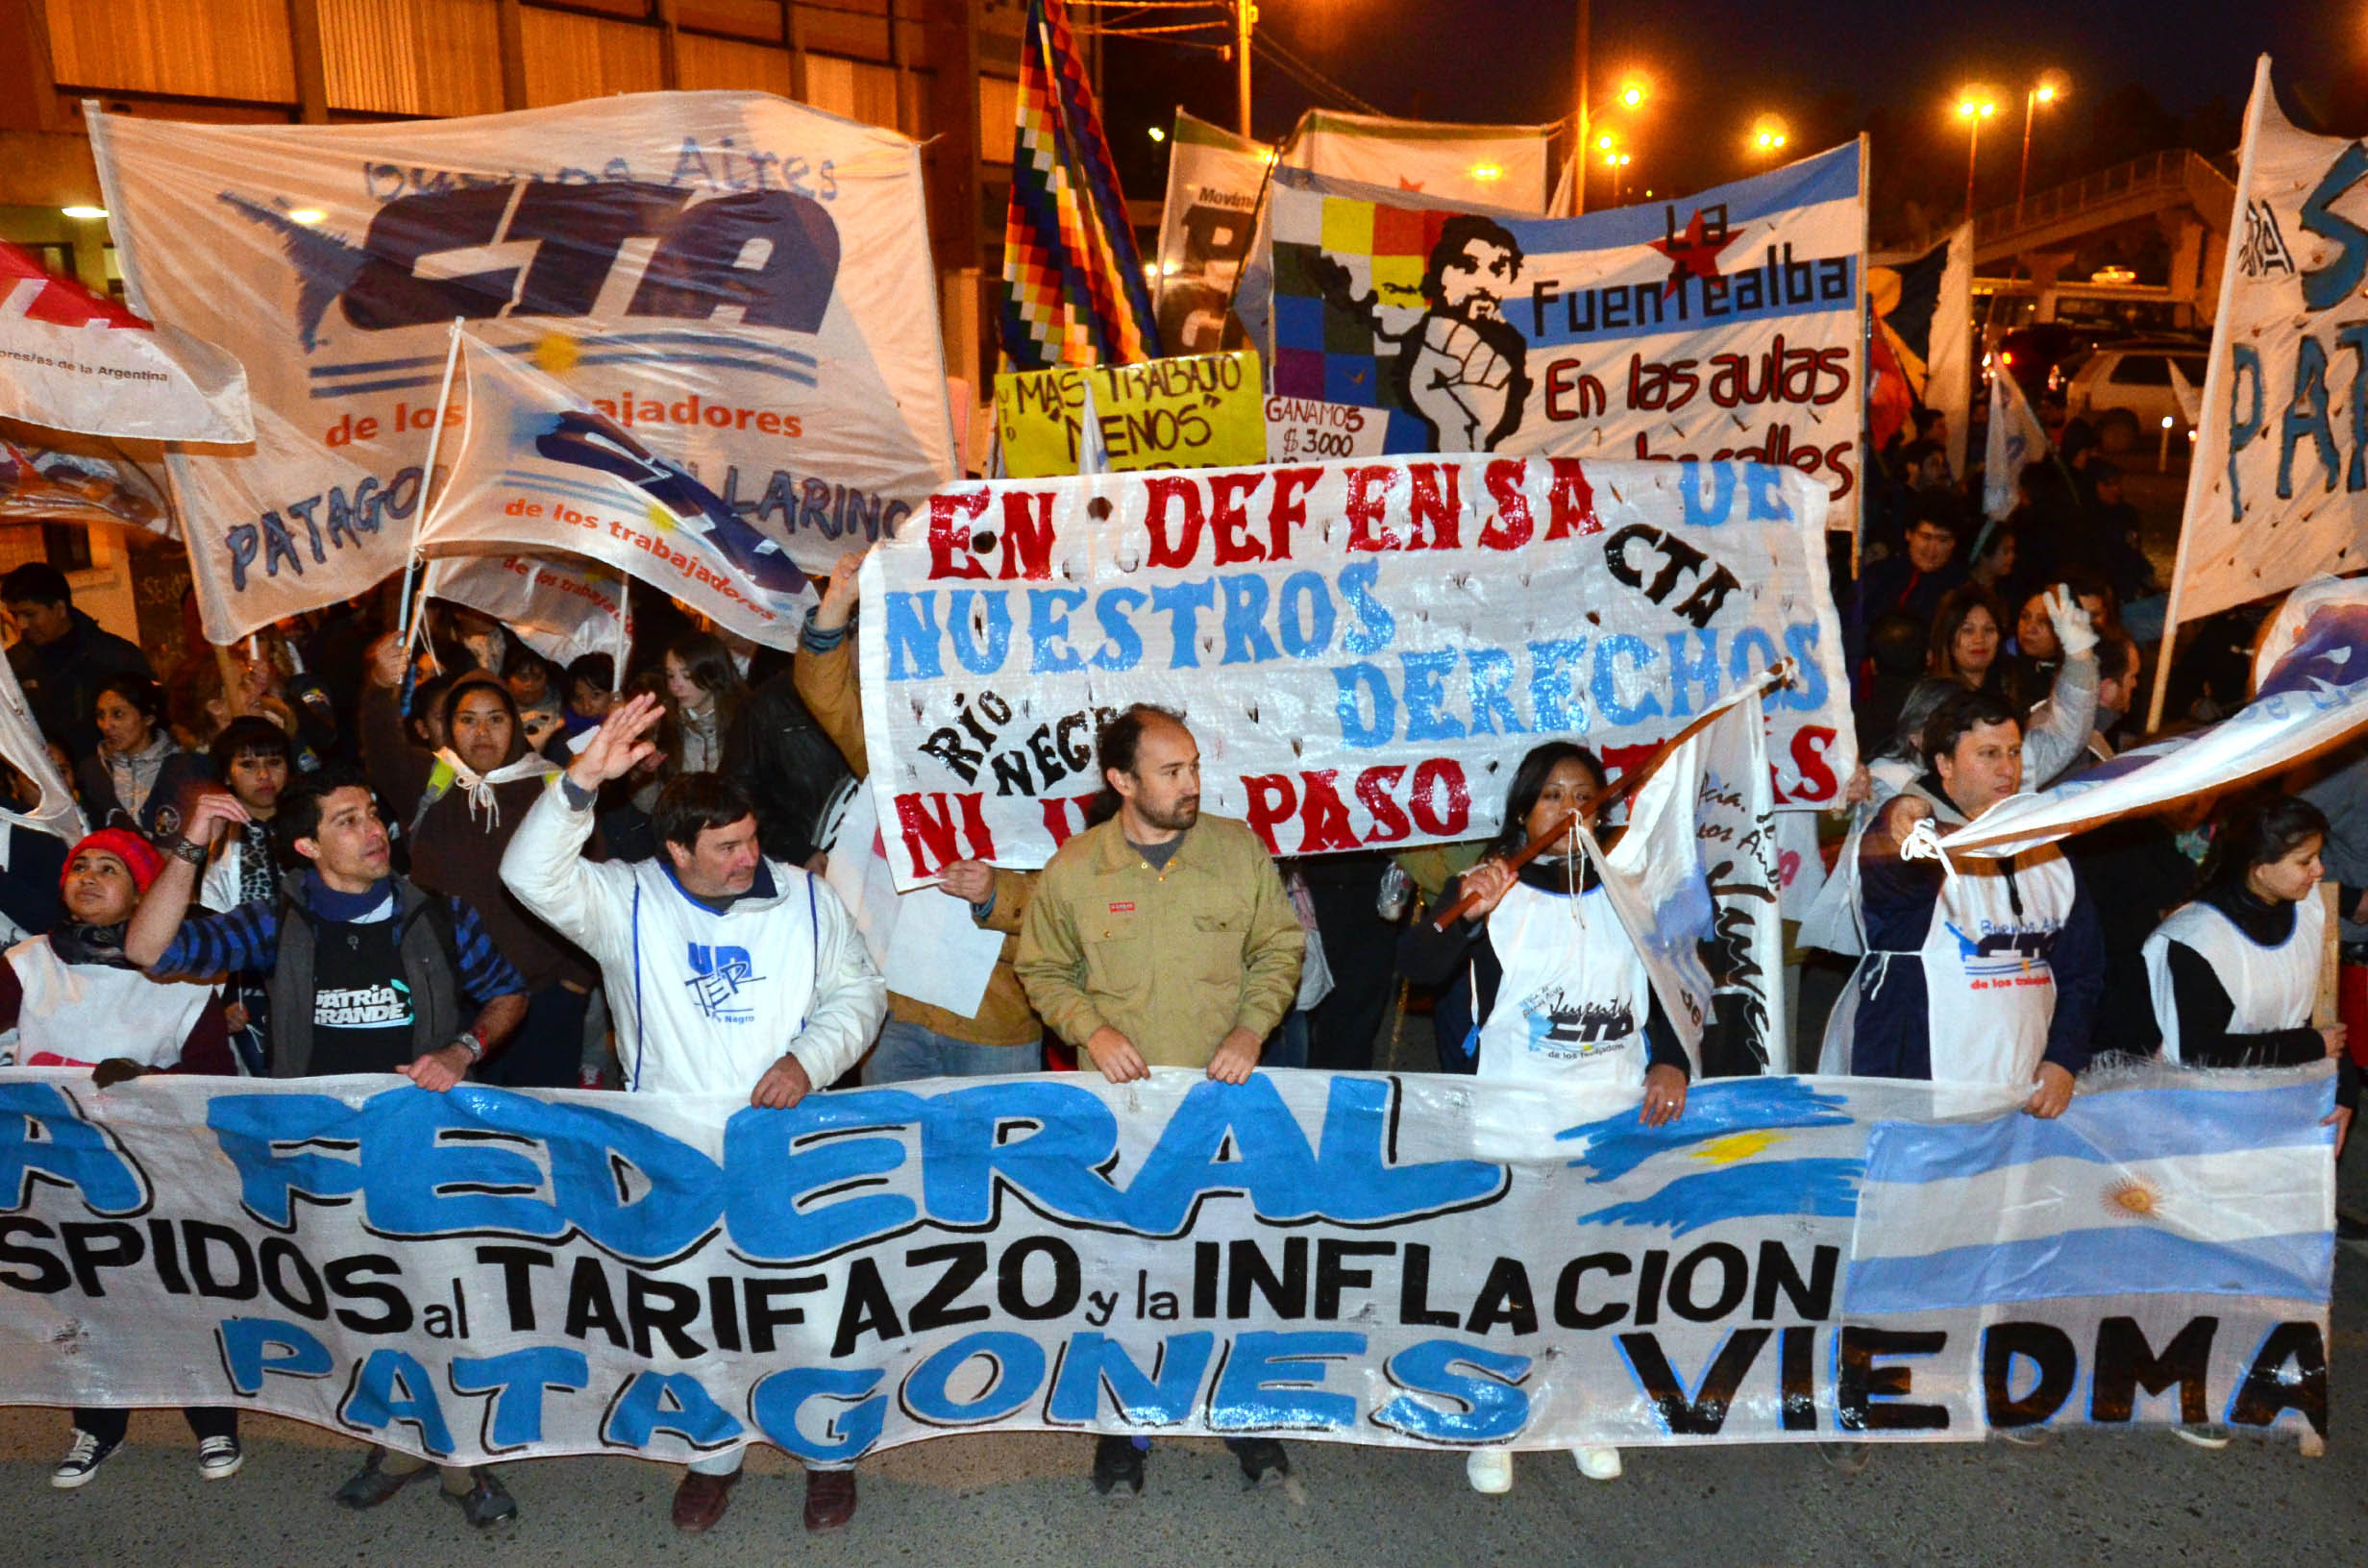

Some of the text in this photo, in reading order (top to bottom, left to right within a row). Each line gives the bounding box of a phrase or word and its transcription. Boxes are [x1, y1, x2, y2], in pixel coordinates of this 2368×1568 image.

[1665, 203, 1728, 253] La
[1534, 242, 1849, 337] Fuentealba
[58, 360, 75, 372] de
[81, 364, 93, 375] la
[97, 366, 168, 381] Argentina
[326, 390, 803, 448] de los ajadores
[1016, 353, 1242, 415] MAS TRABAJO
[1545, 334, 1851, 422] En las aulas
[506, 499, 777, 621] de los trabajadores
[928, 485, 1057, 580] EN
[1144, 458, 1605, 569] DEFENSA
[885, 556, 1395, 681] NUESTROS
[1603, 524, 1741, 628] CTA
[1335, 618, 1828, 749] DERECHOS
[894, 792, 997, 879] NI
[1240, 757, 1470, 855] PASO
[1971, 979, 1988, 990] de
[208, 1072, 1511, 1268] FEDERAL
[424, 1277, 469, 1339] al
[477, 1237, 1082, 1360] TARIFAZO
[1086, 1288, 1120, 1325] y
[1138, 1269, 1180, 1320] la
[1194, 1237, 1840, 1337] INFLACION
[215, 1315, 2329, 1467] PATAGONES VIEDMA
